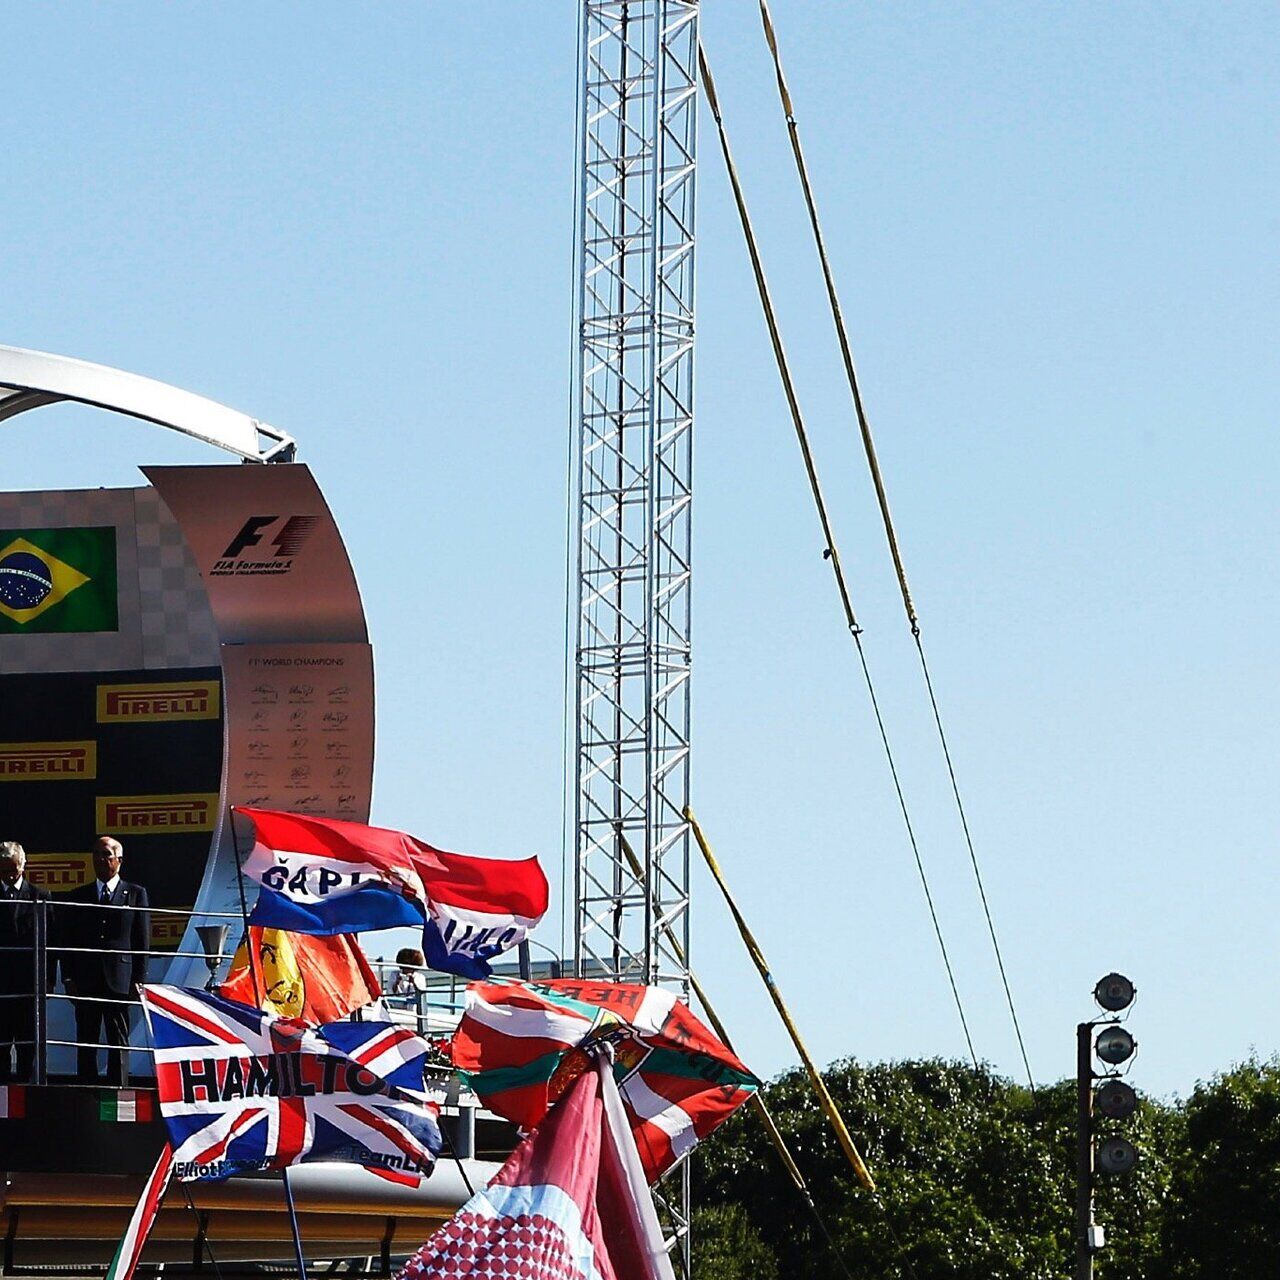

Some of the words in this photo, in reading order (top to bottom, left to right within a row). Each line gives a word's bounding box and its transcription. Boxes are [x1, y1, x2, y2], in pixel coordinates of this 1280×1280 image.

[222, 516, 322, 558] F1
[213, 560, 233, 570] FIA
[236, 560, 283, 569] Formula
[263, 658, 292, 666] WORLD
[293, 658, 344, 666] CHAMPIONS
[106, 688, 209, 715] PIRELLI
[105, 800, 208, 828] PIRELLI
